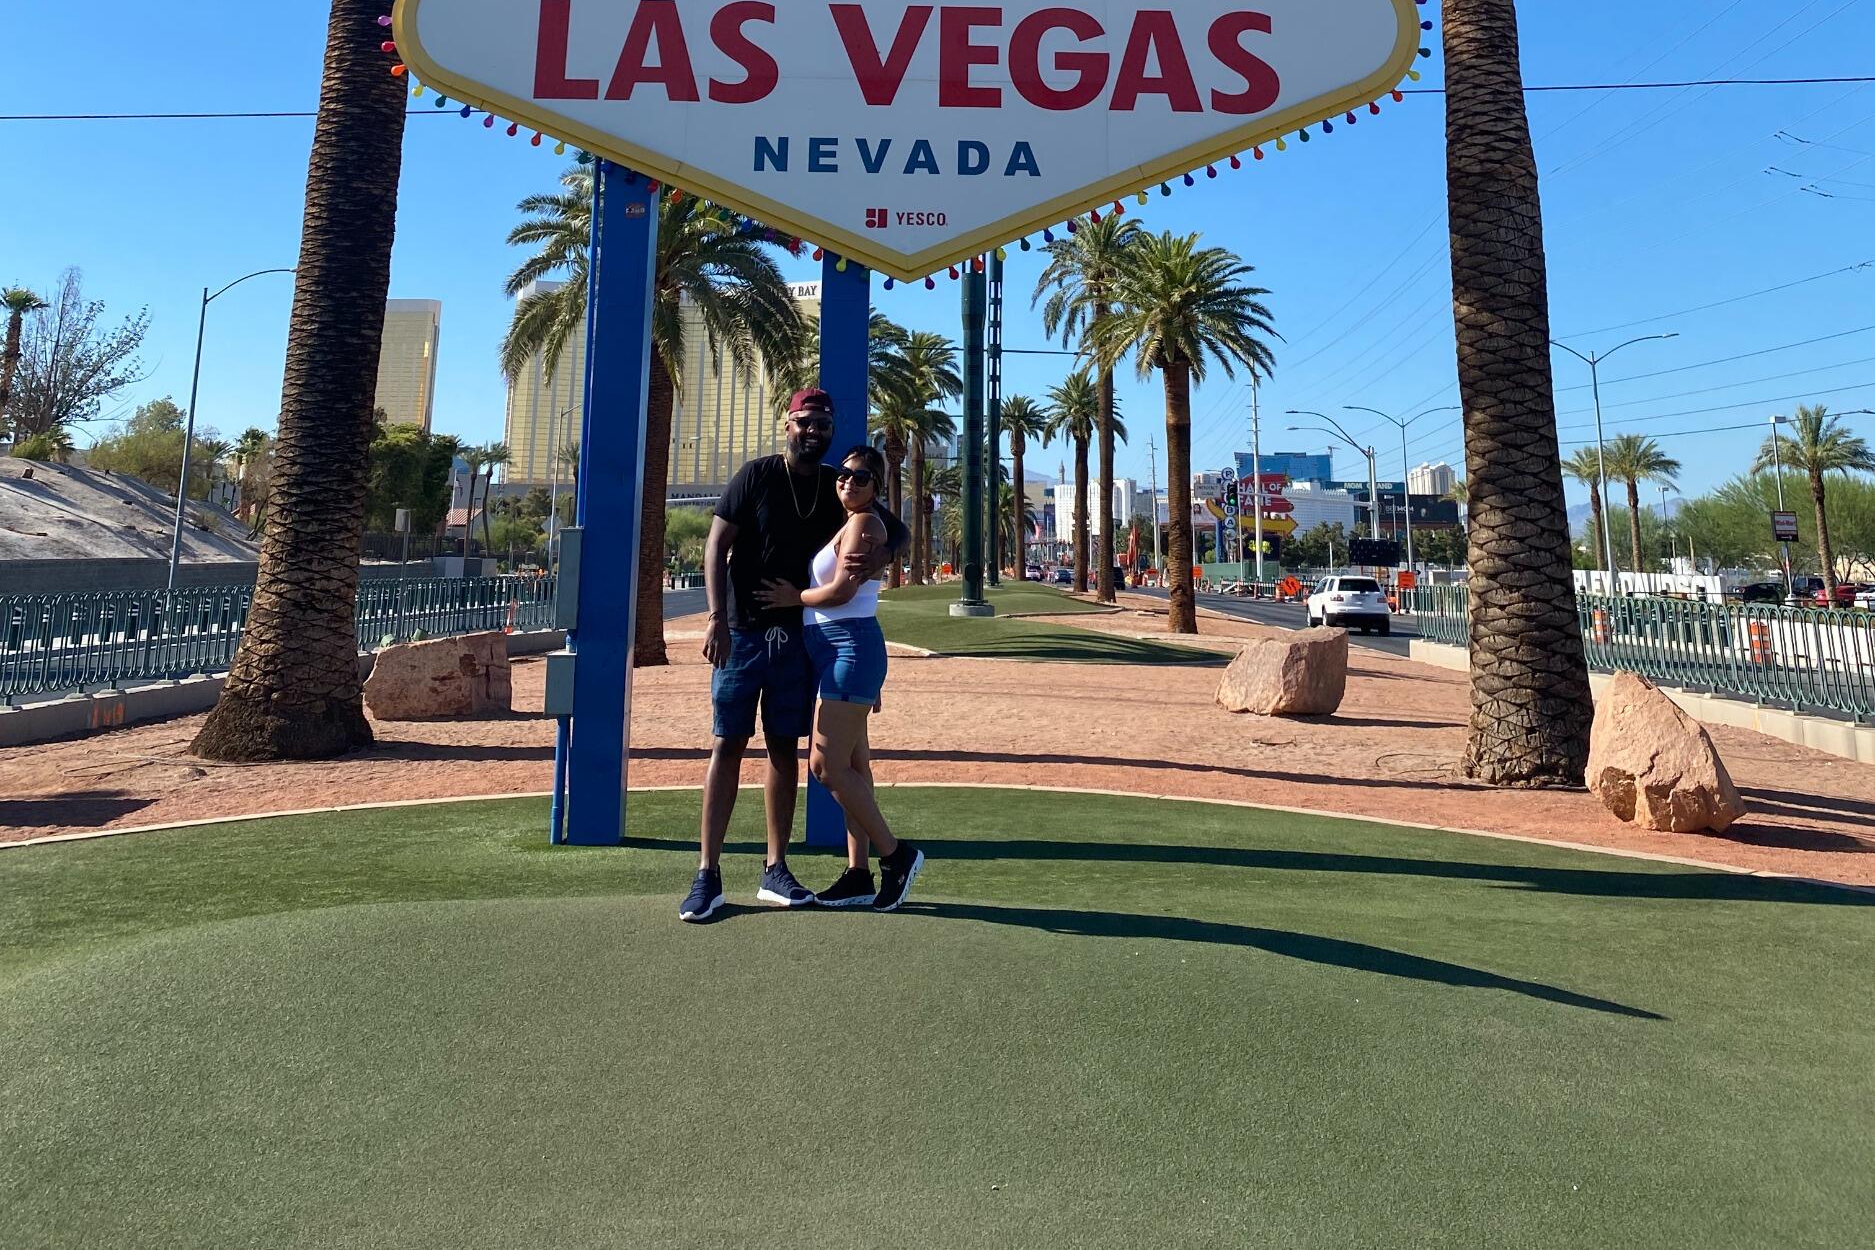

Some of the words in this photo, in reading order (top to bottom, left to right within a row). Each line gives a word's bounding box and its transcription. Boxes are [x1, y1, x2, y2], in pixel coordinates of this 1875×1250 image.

[828, 4, 1280, 114] VEGAS
[753, 135, 1041, 178] NEVADA
[896, 212, 947, 226] YESCO
[797, 285, 818, 297] BAY
[1238, 482, 1269, 494] HAL
[1269, 483, 1282, 491] OF
[1343, 482, 1363, 490] MGM
[1366, 482, 1393, 490] GAND
